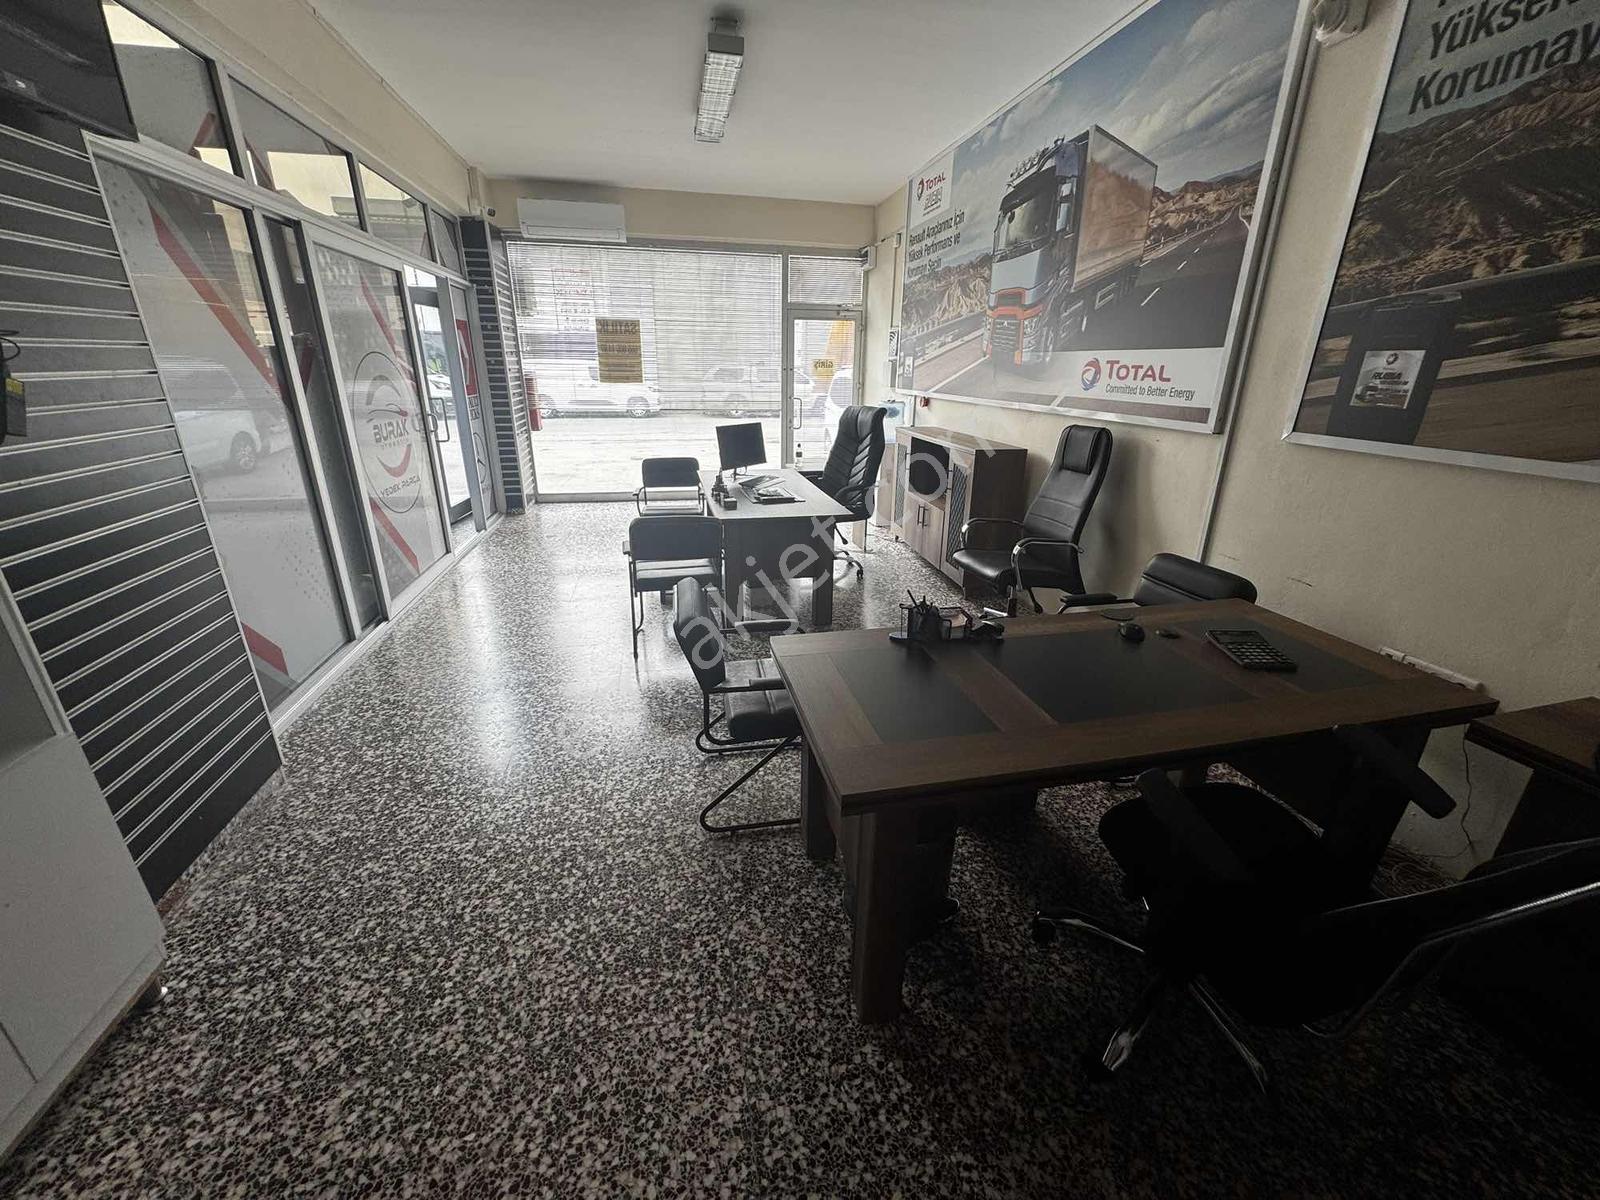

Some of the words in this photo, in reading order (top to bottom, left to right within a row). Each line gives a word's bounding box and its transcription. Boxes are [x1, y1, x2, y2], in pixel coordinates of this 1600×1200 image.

[1431, 0, 1579, 60] Yükse
[925, 172, 946, 191] TOTAL
[1106, 359, 1171, 383] TOTAL
[1105, 383, 1139, 396] Committed
[1138, 385, 1146, 396] to
[1146, 386, 1168, 398] Better
[1169, 386, 1196, 402] Energy
[373, 418, 409, 443] BURAK
[380, 483, 400, 498] YEDEK
